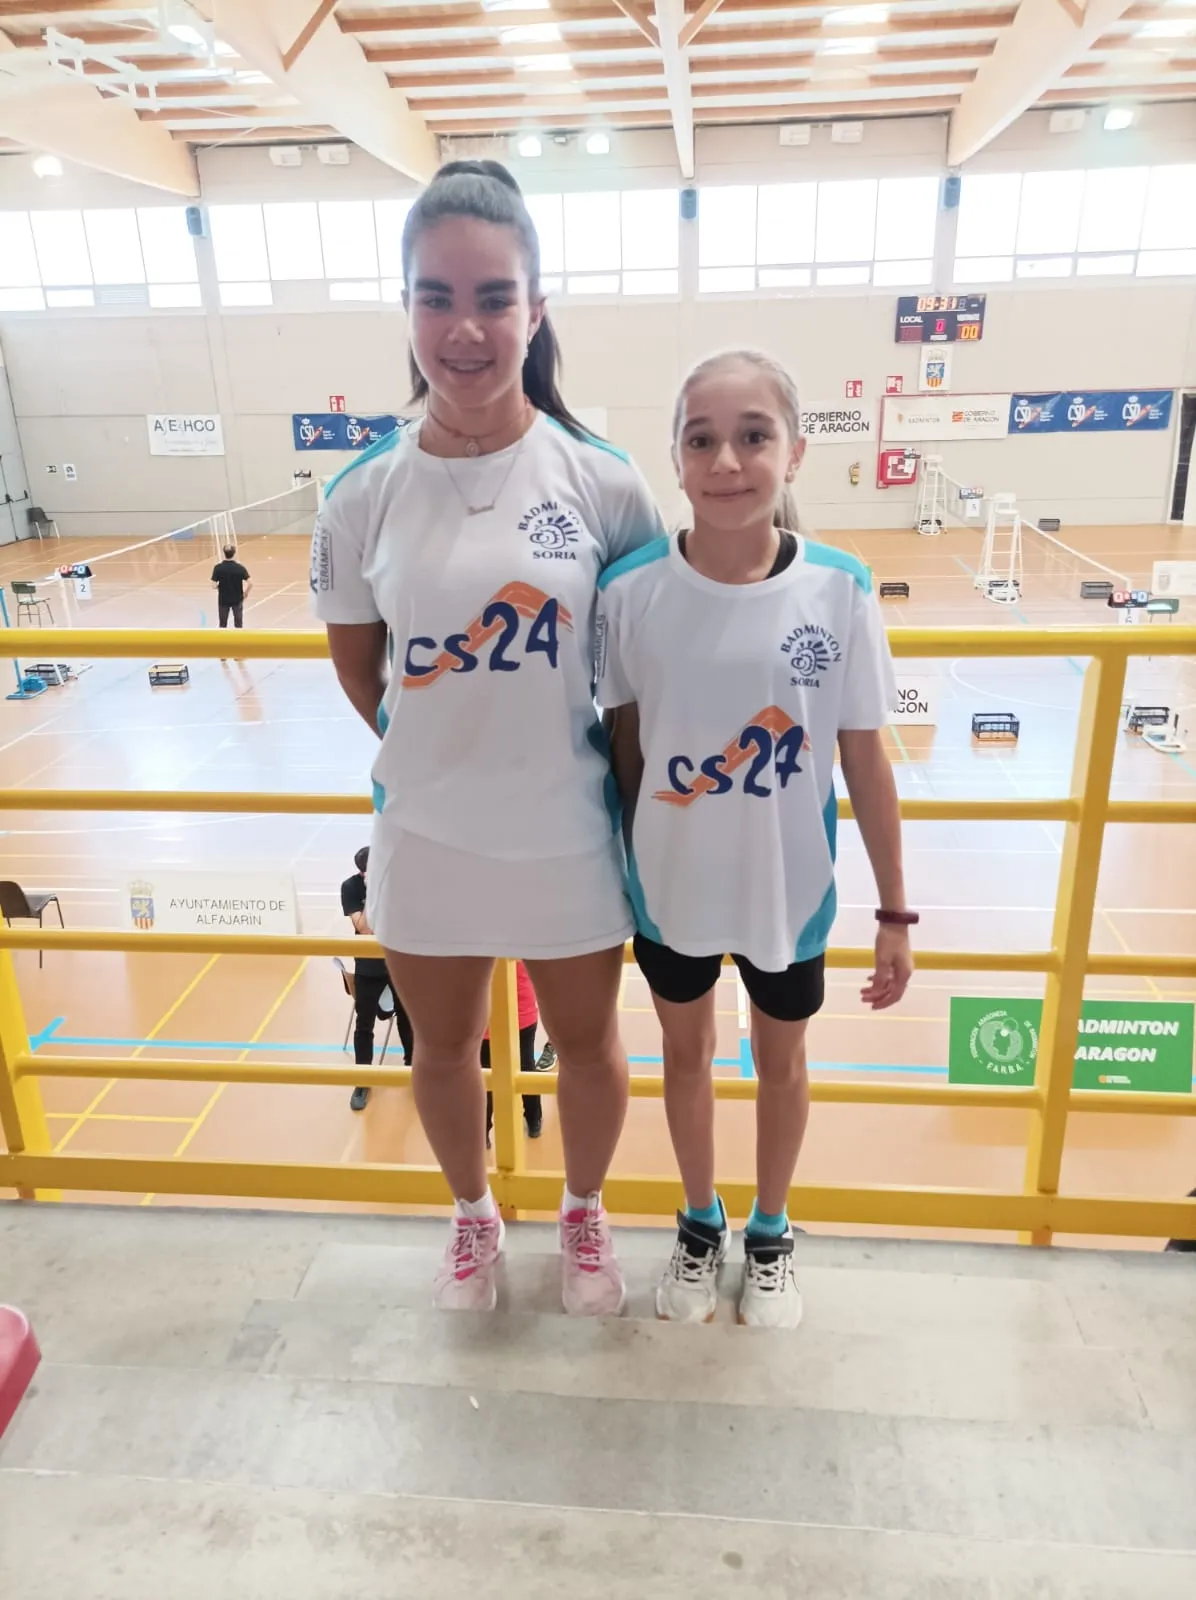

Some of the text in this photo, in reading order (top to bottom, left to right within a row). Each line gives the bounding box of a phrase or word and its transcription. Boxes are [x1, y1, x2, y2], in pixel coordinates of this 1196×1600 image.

[801, 410, 862, 423] GOBIERNO
[819, 421, 870, 433] ARAGON
[532, 550, 577, 560] SORIA
[780, 624, 842, 662] BADMINTON
[790, 676, 820, 688] SORIA
[169, 897, 287, 911] AYUNTAMIENTO DE
[1074, 1046, 1157, 1063] ARAGON
